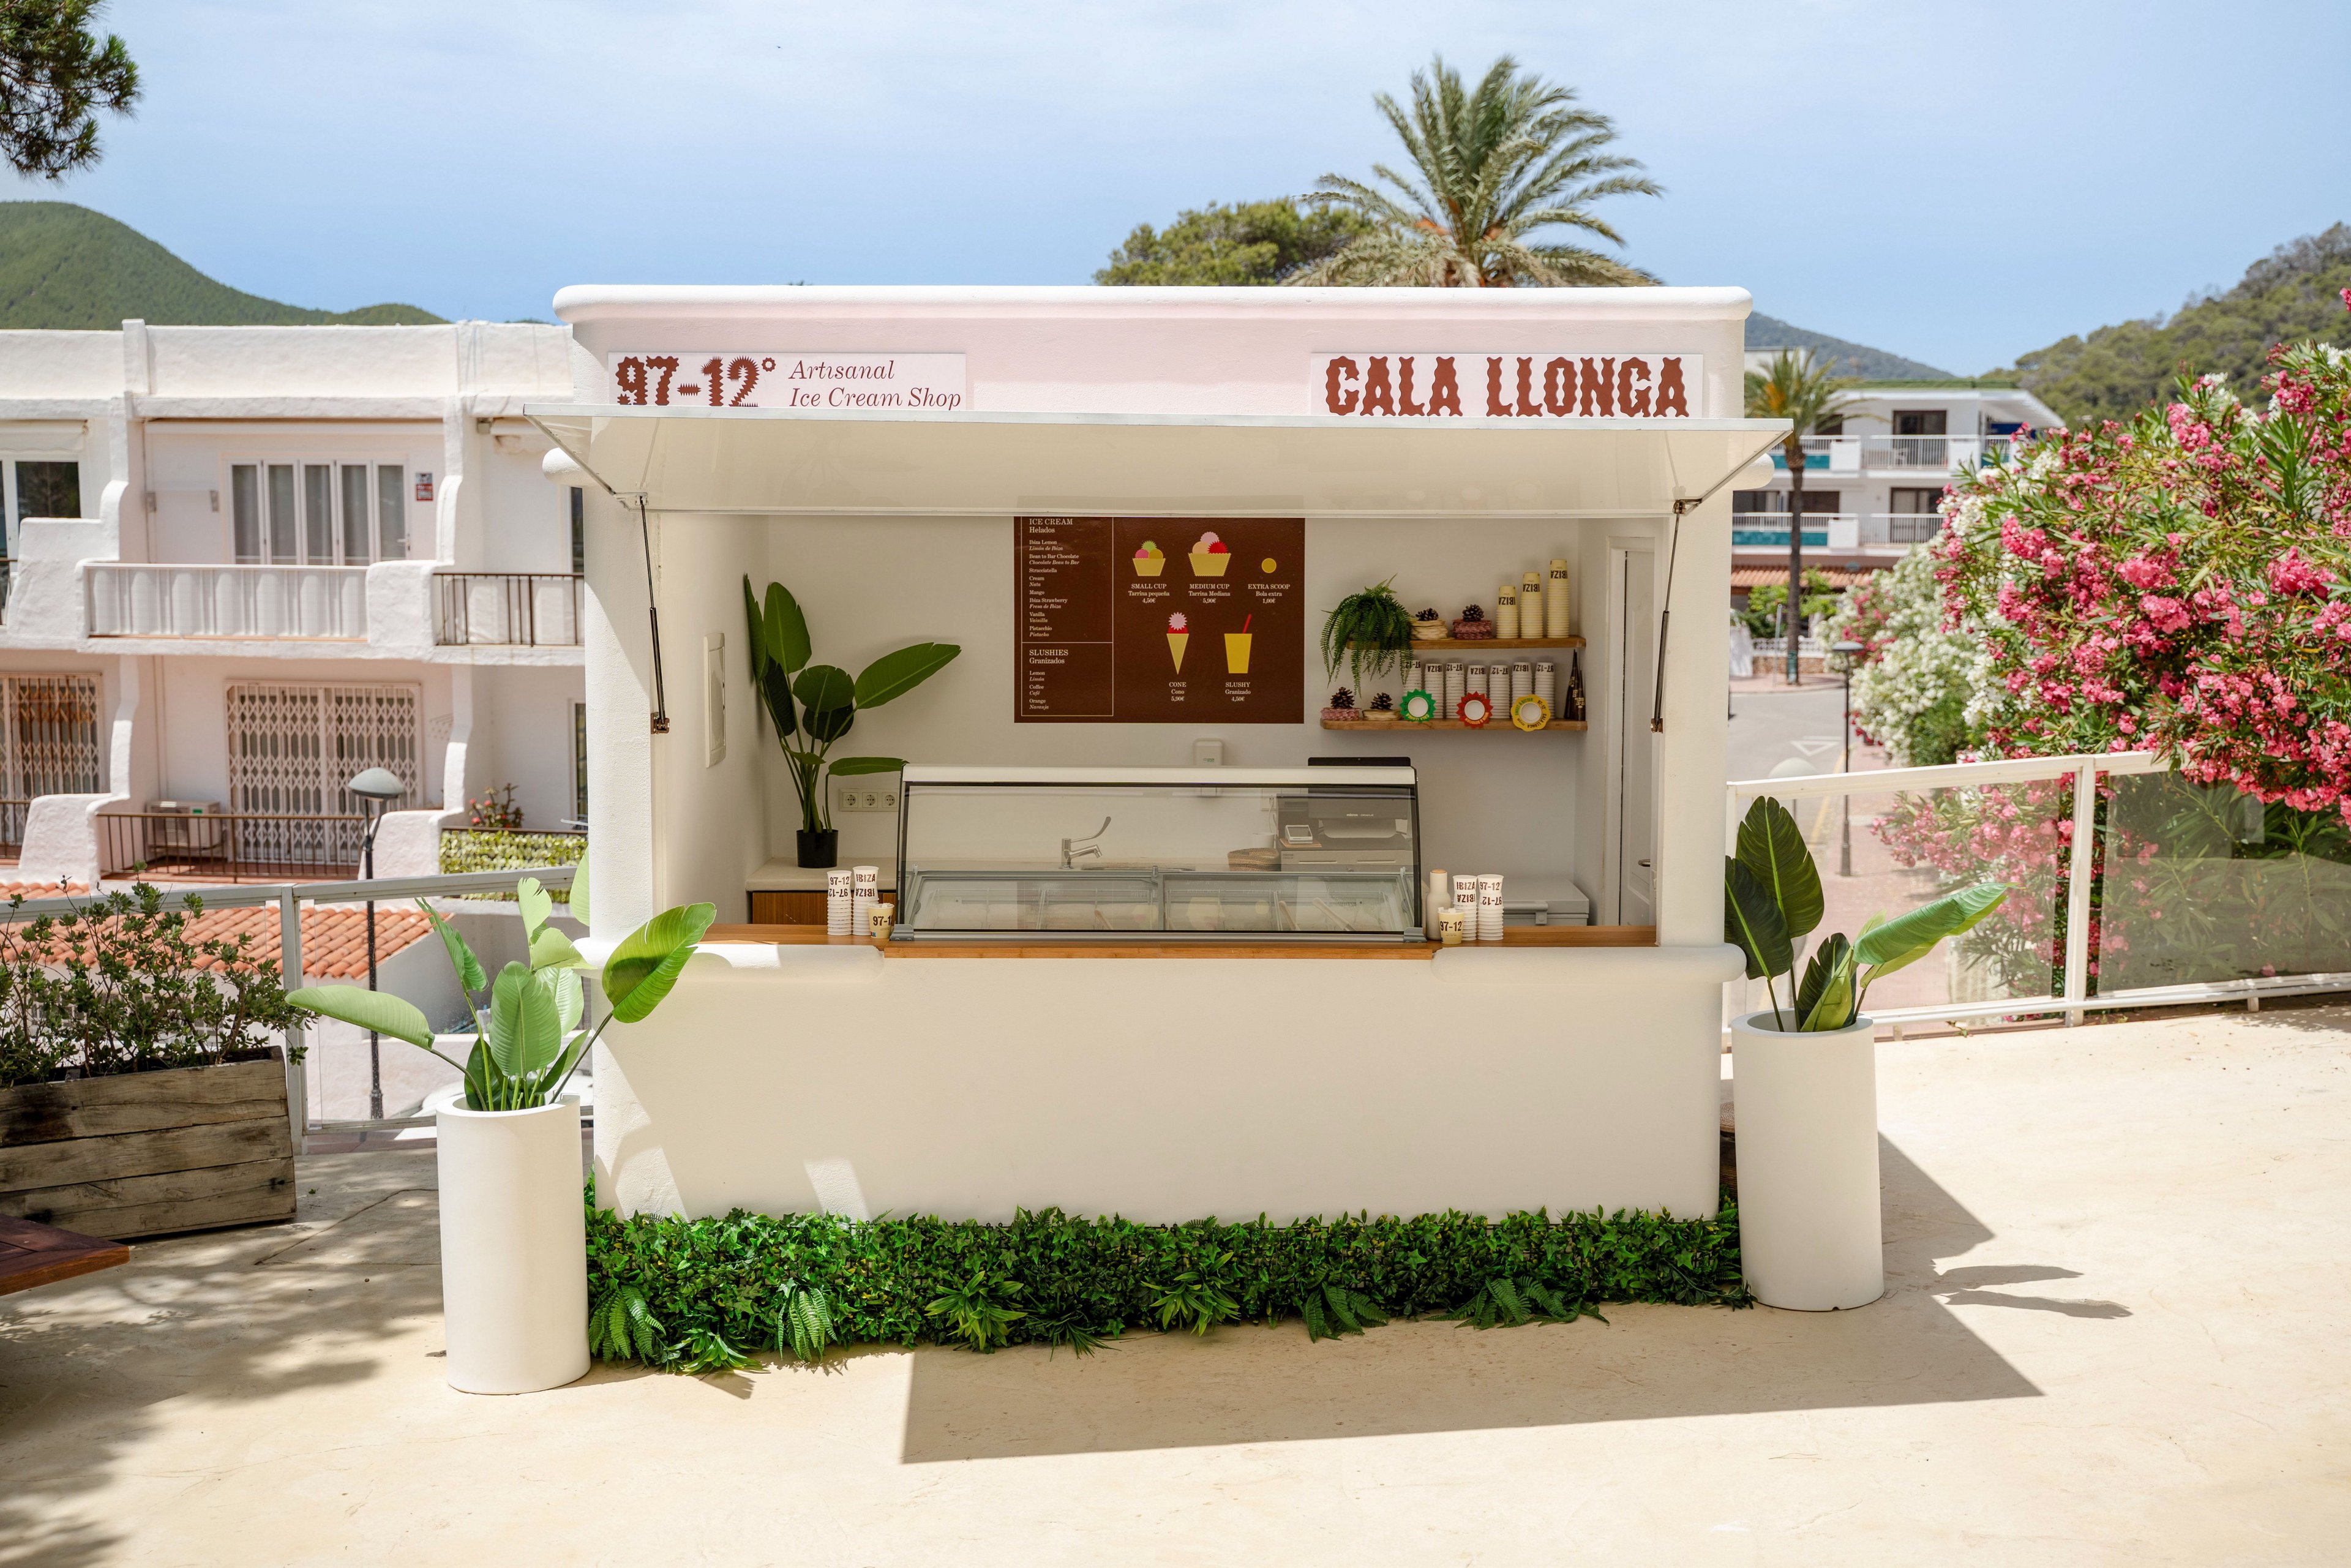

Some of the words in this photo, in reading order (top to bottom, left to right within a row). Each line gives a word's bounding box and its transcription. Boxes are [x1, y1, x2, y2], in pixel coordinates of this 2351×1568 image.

[788, 359, 895, 380] Artisanal
[1325, 356, 1463, 416] CALA
[1486, 356, 1690, 418] LLONGA
[789, 387, 823, 408] Ice
[828, 387, 903, 407] Cream
[907, 387, 962, 411] Shop
[1550, 570, 1567, 579] IBIZA
[1523, 583, 1540, 592] IBIZA
[1499, 596, 1516, 605] IBIZA
[856, 874, 876, 883] IBIZA
[1457, 882, 1475, 890] IBIZA
[856, 888, 875, 897] IBIZA
[1457, 894, 1475, 902] IBIZA
